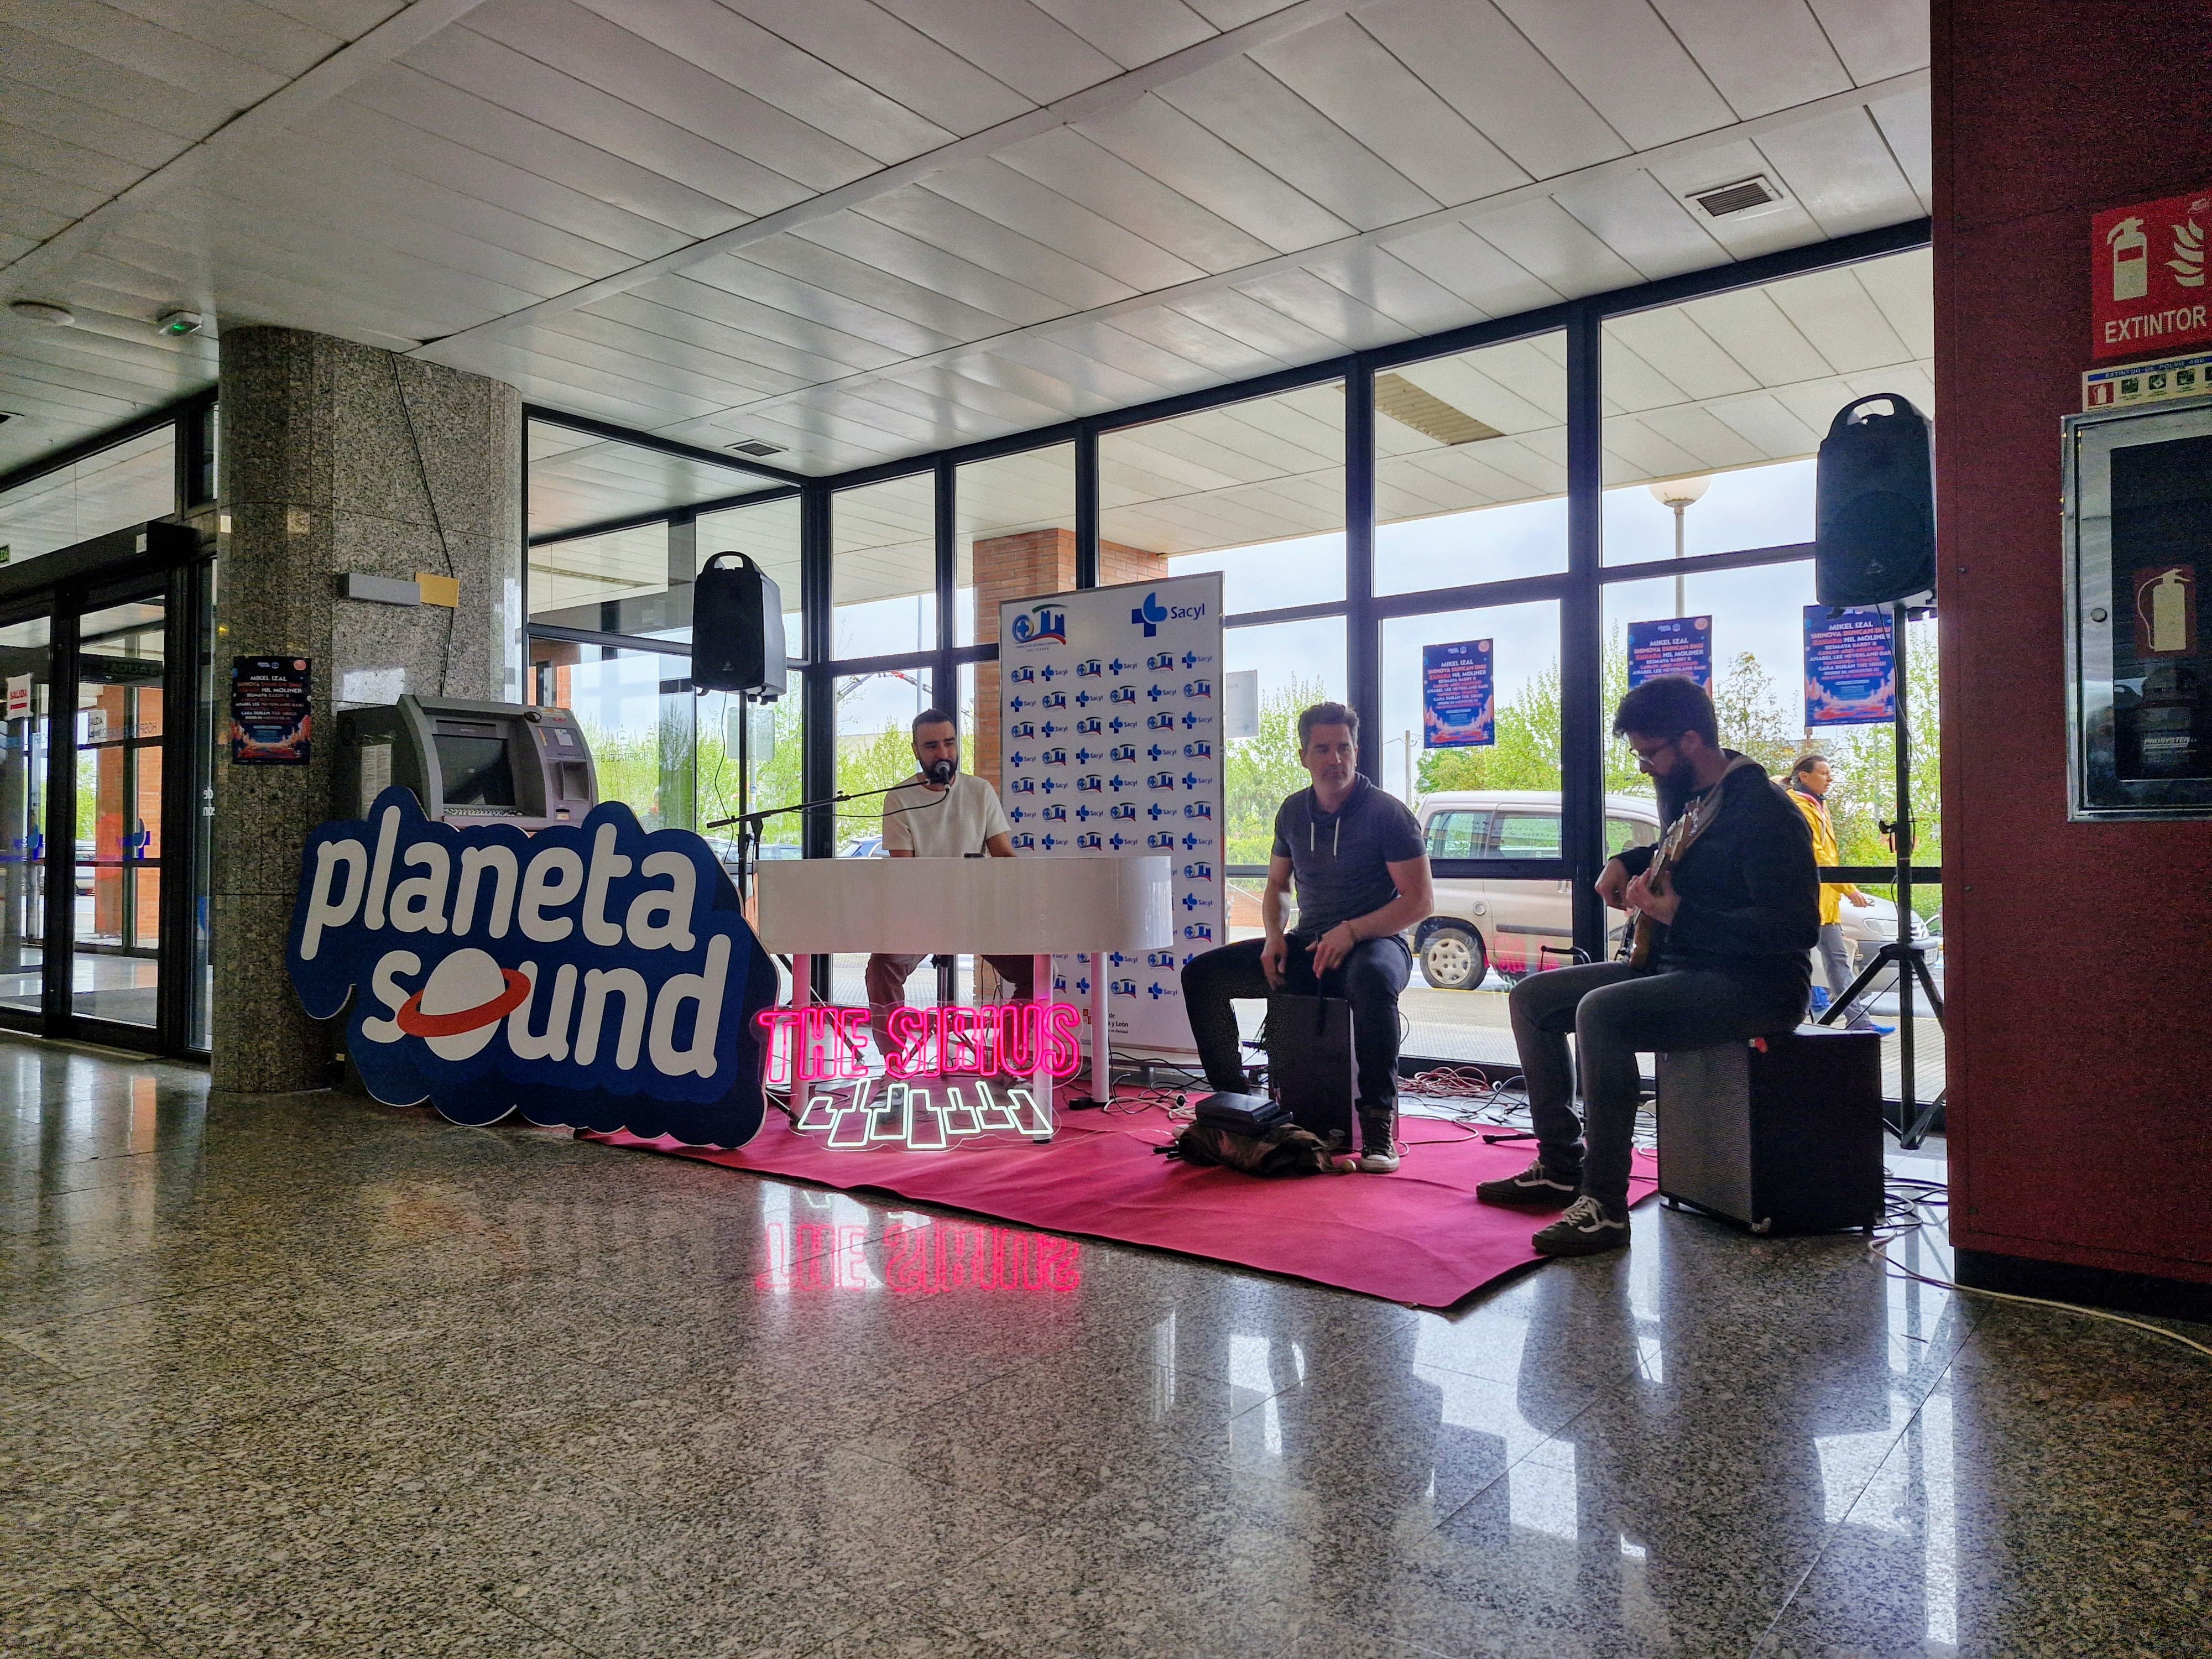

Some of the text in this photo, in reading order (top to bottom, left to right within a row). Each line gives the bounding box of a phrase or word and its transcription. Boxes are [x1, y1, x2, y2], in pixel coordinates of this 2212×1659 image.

[2105, 305, 2207, 344] EXTINTOR
[1171, 603, 1204, 620] Sacyl
[1811, 631, 1842, 639] SHINOVA
[1829, 623, 1854, 631] MIKEL
[10, 689, 27, 700] SALIDA
[300, 805, 697, 960] planeta
[361, 933, 731, 1078] sound
[758, 1004, 1081, 1082] THE SIRIUS
